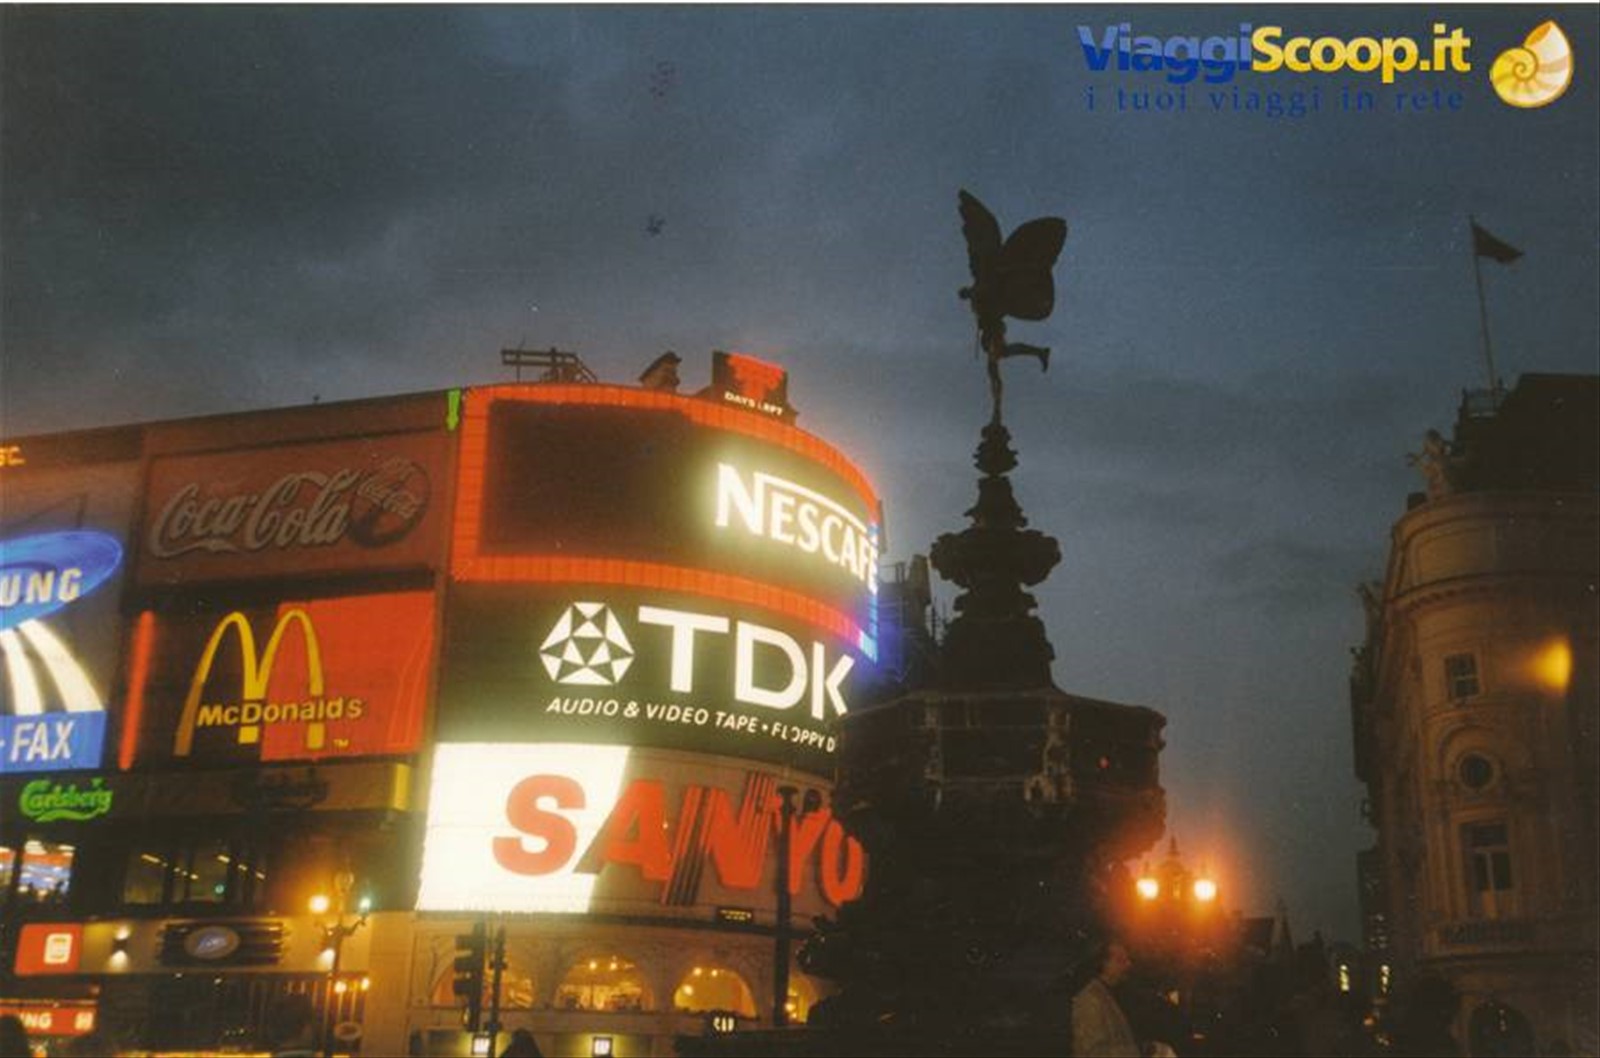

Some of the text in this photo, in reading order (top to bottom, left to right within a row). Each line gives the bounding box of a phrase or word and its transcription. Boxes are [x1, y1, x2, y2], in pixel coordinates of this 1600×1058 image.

[151, 469, 360, 560] Coca-Cola
[0, 567, 82, 608] UNG
[638, 605, 855, 721] TDK
[10, 721, 76, 763] FAX
[546, 697, 620, 717] AUDIO
[623, 700, 640, 719] &
[645, 703, 709, 726] VIDEO
[715, 710, 759, 733] TAPE
[771, 721, 826, 750] FLOPPY
[492, 771, 866, 908] SANYO
